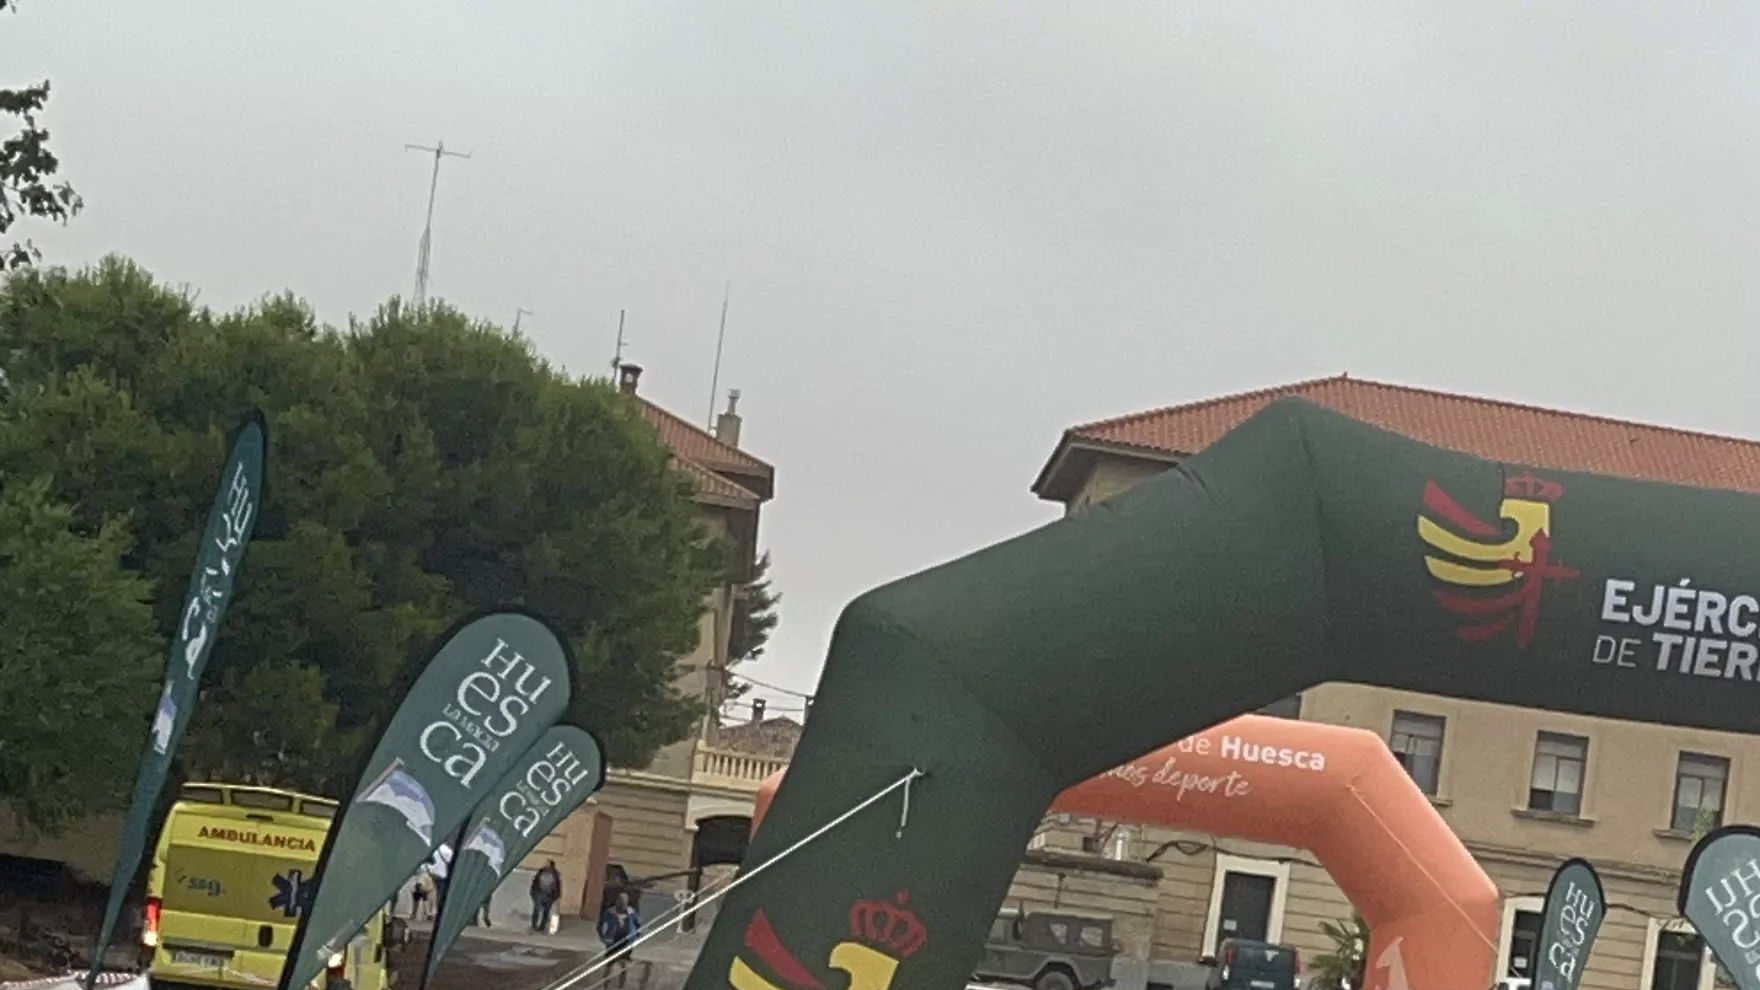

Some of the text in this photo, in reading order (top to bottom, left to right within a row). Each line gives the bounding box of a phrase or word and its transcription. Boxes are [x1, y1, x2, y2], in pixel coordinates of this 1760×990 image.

[1592, 634, 1642, 668] DE
[1219, 734, 1327, 771] Huesca
[1152, 756, 1251, 801] deporte
[197, 825, 316, 852] AMBULANCIA
